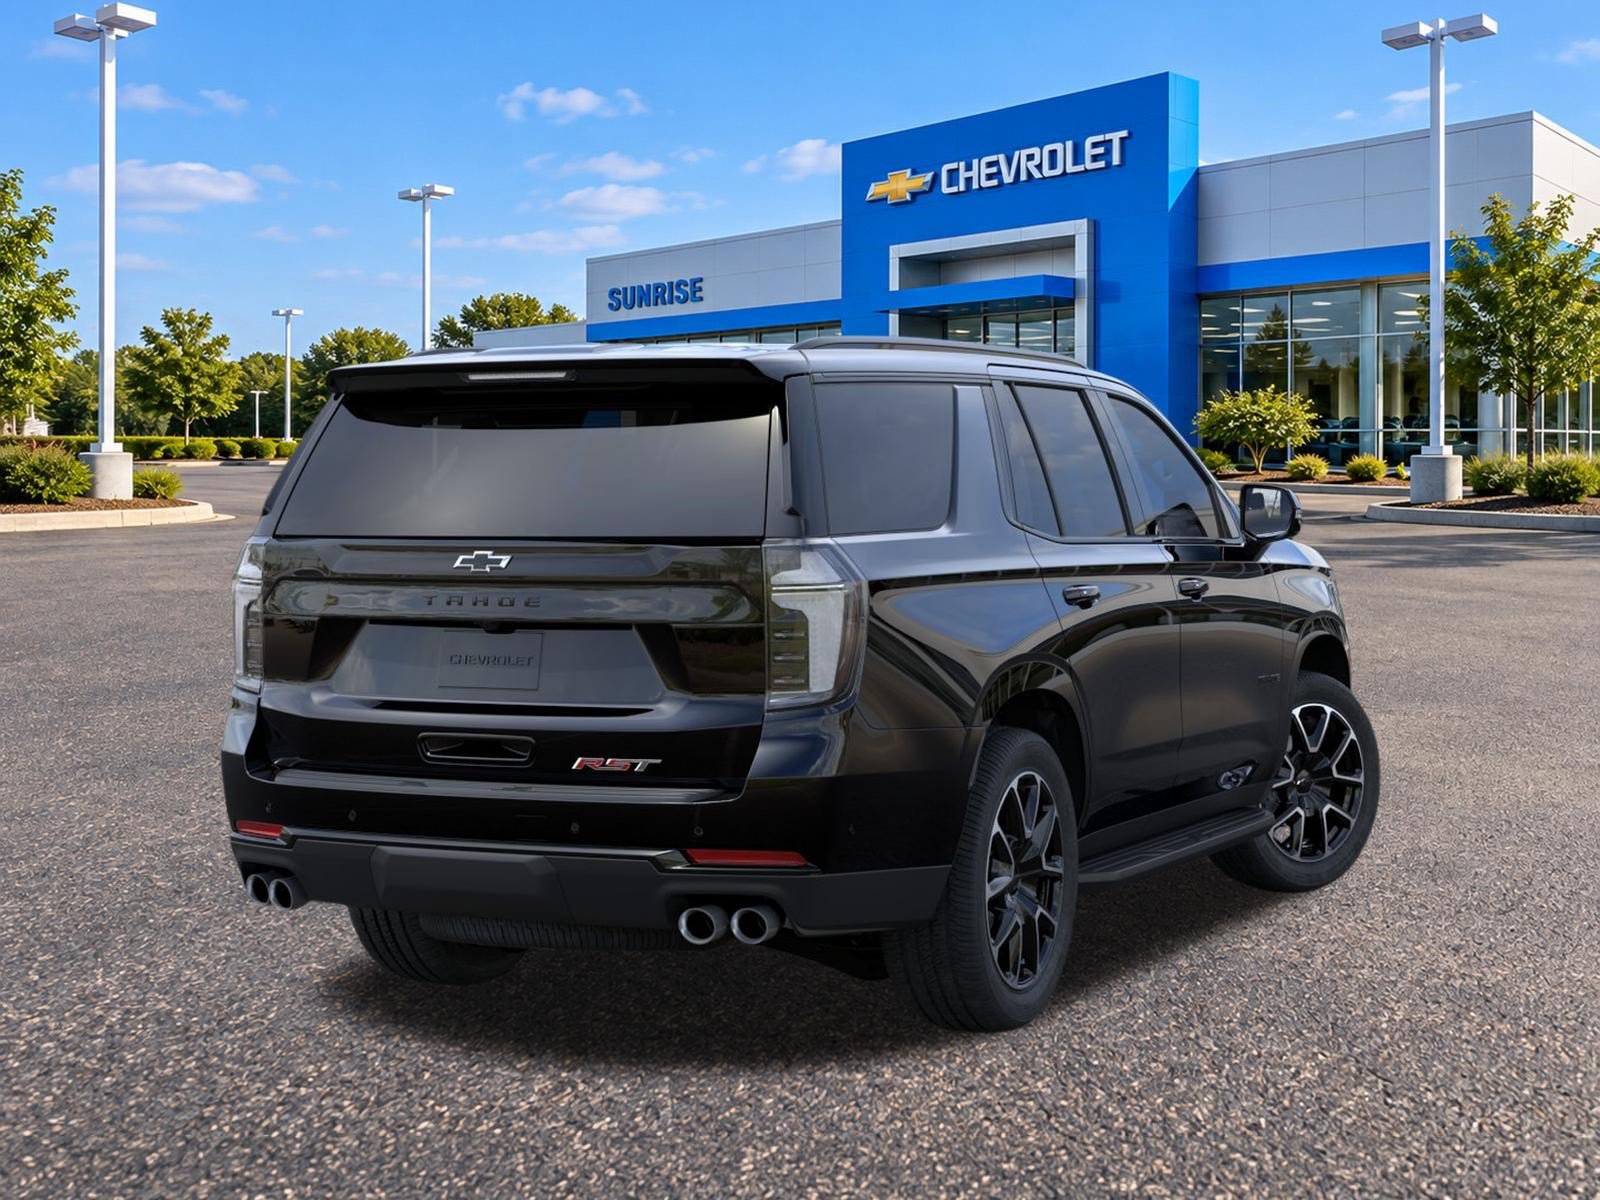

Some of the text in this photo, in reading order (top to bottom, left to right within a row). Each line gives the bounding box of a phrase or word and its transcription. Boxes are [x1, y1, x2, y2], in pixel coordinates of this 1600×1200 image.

[941, 130, 1129, 195] CHEVROLET
[607, 277, 704, 311] SUNRISE
[423, 595, 541, 608] TAHOE
[449, 654, 534, 667] CHEVROLET
[571, 757, 663, 772] RST
